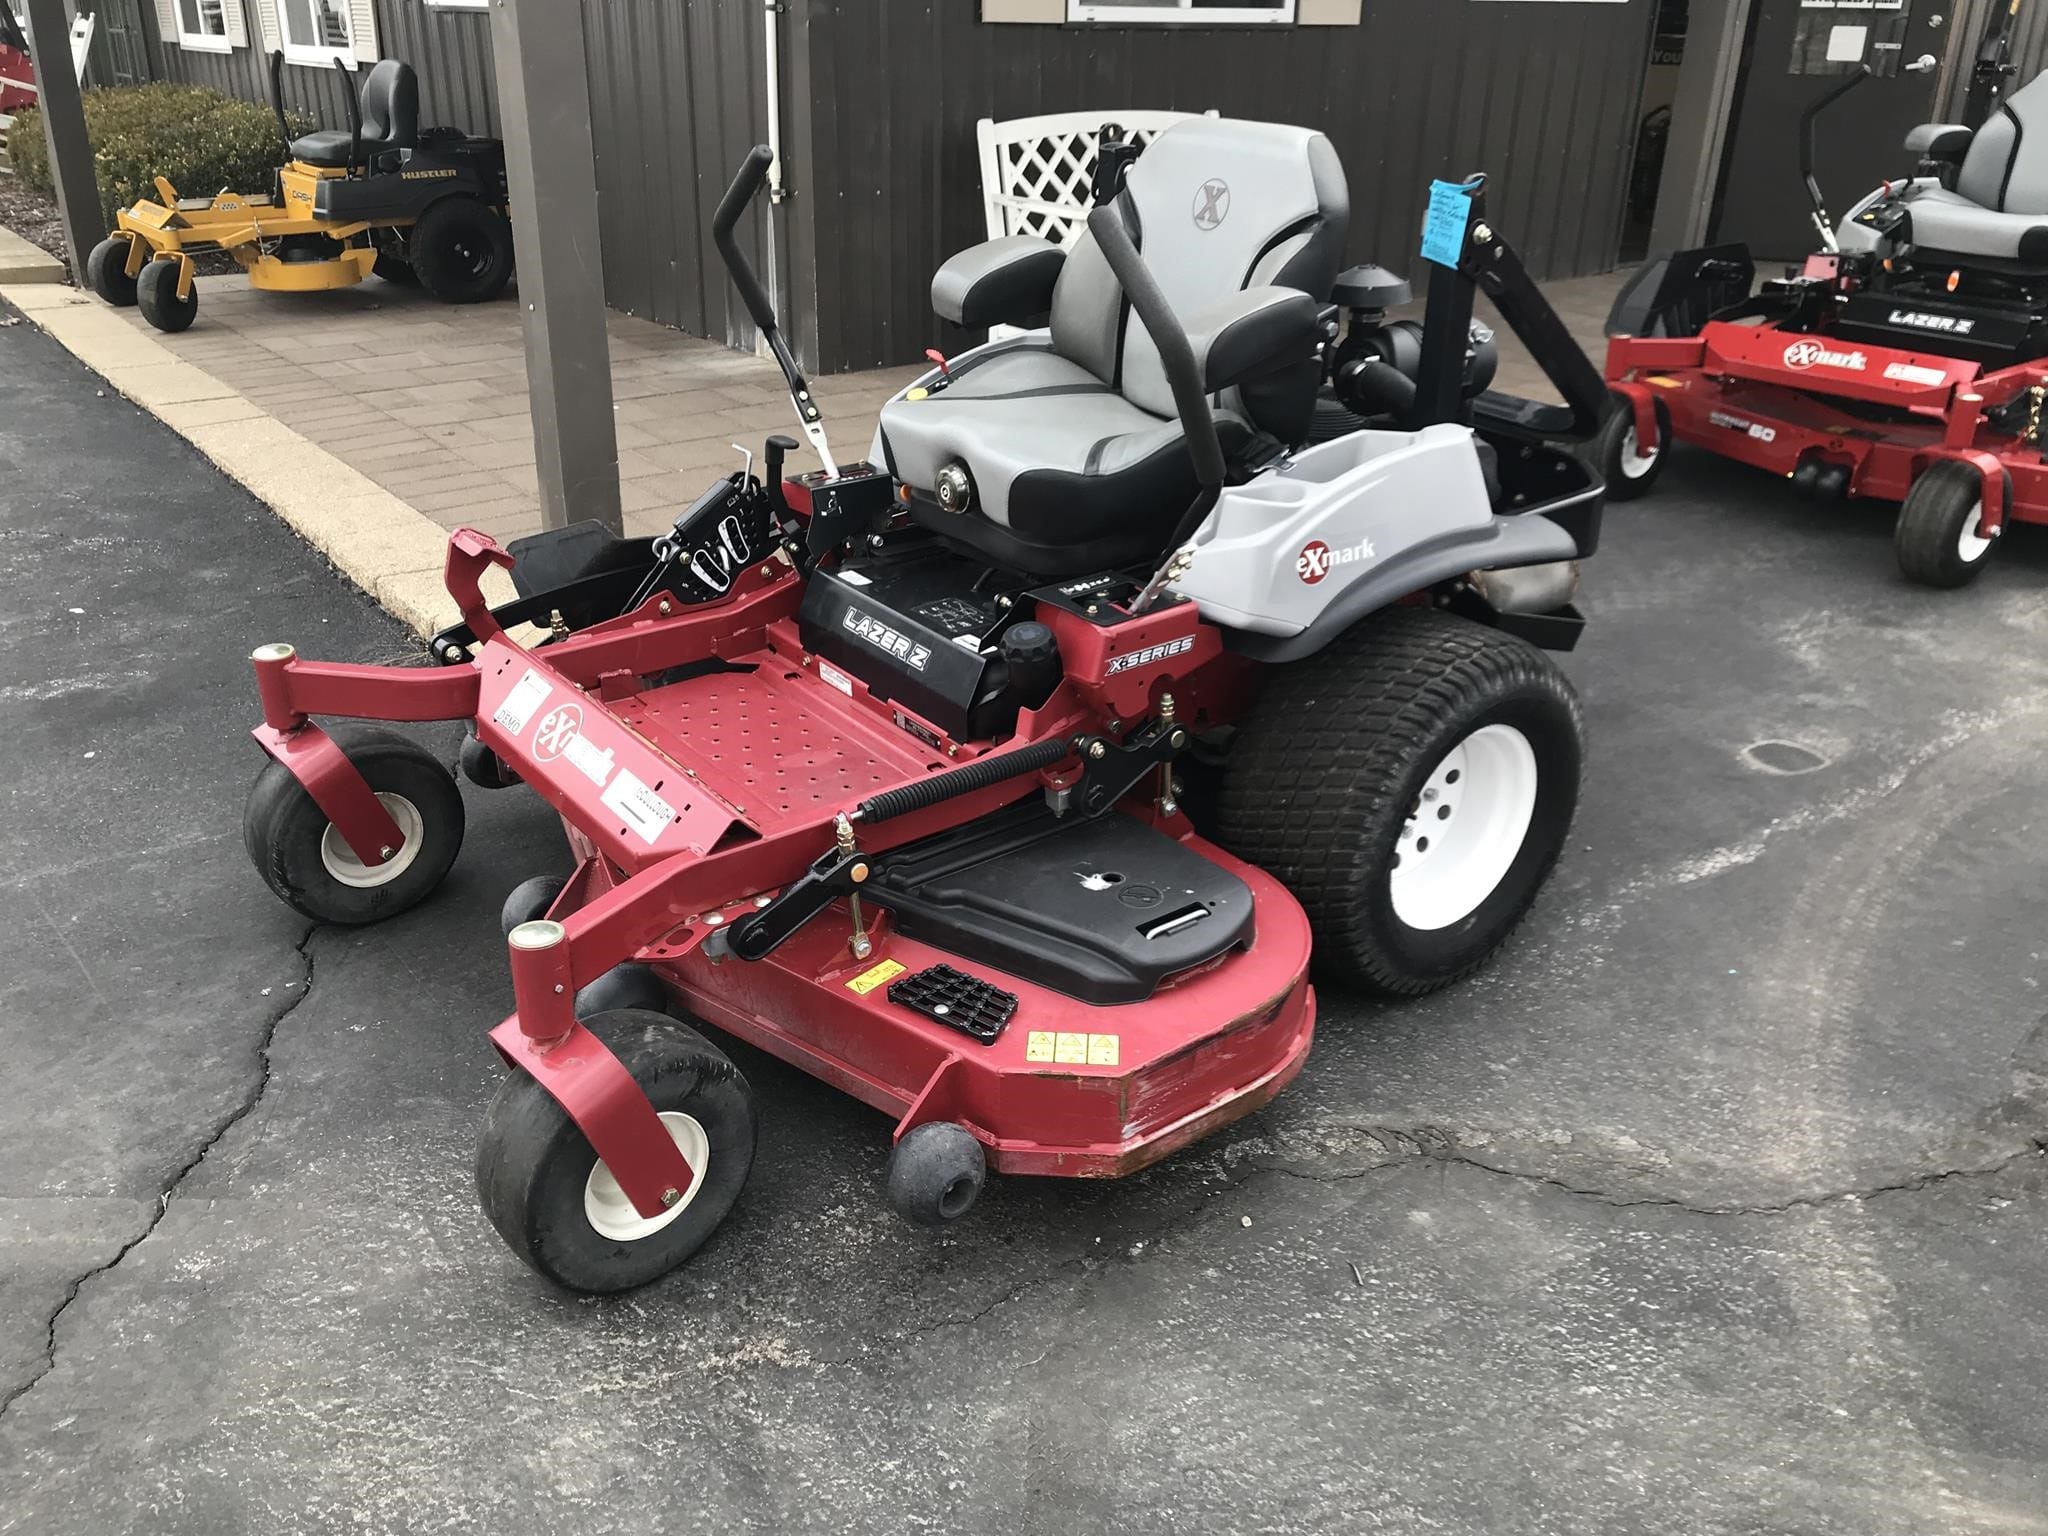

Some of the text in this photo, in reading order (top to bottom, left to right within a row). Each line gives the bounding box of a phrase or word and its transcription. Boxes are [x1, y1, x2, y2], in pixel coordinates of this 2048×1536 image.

[400, 169, 457, 180] HUSTLER
[292, 190, 312, 202] DASH
[1889, 309, 1976, 335] LAZER Z
[1786, 343, 1867, 371] eXmark
[1748, 423, 1776, 442] 60
[1295, 537, 1376, 580] eXmark
[842, 605, 913, 662] LAZER
[906, 642, 932, 672] Z
[1107, 635, 1196, 675] X-SERIES
[496, 709, 521, 733] DEMO
